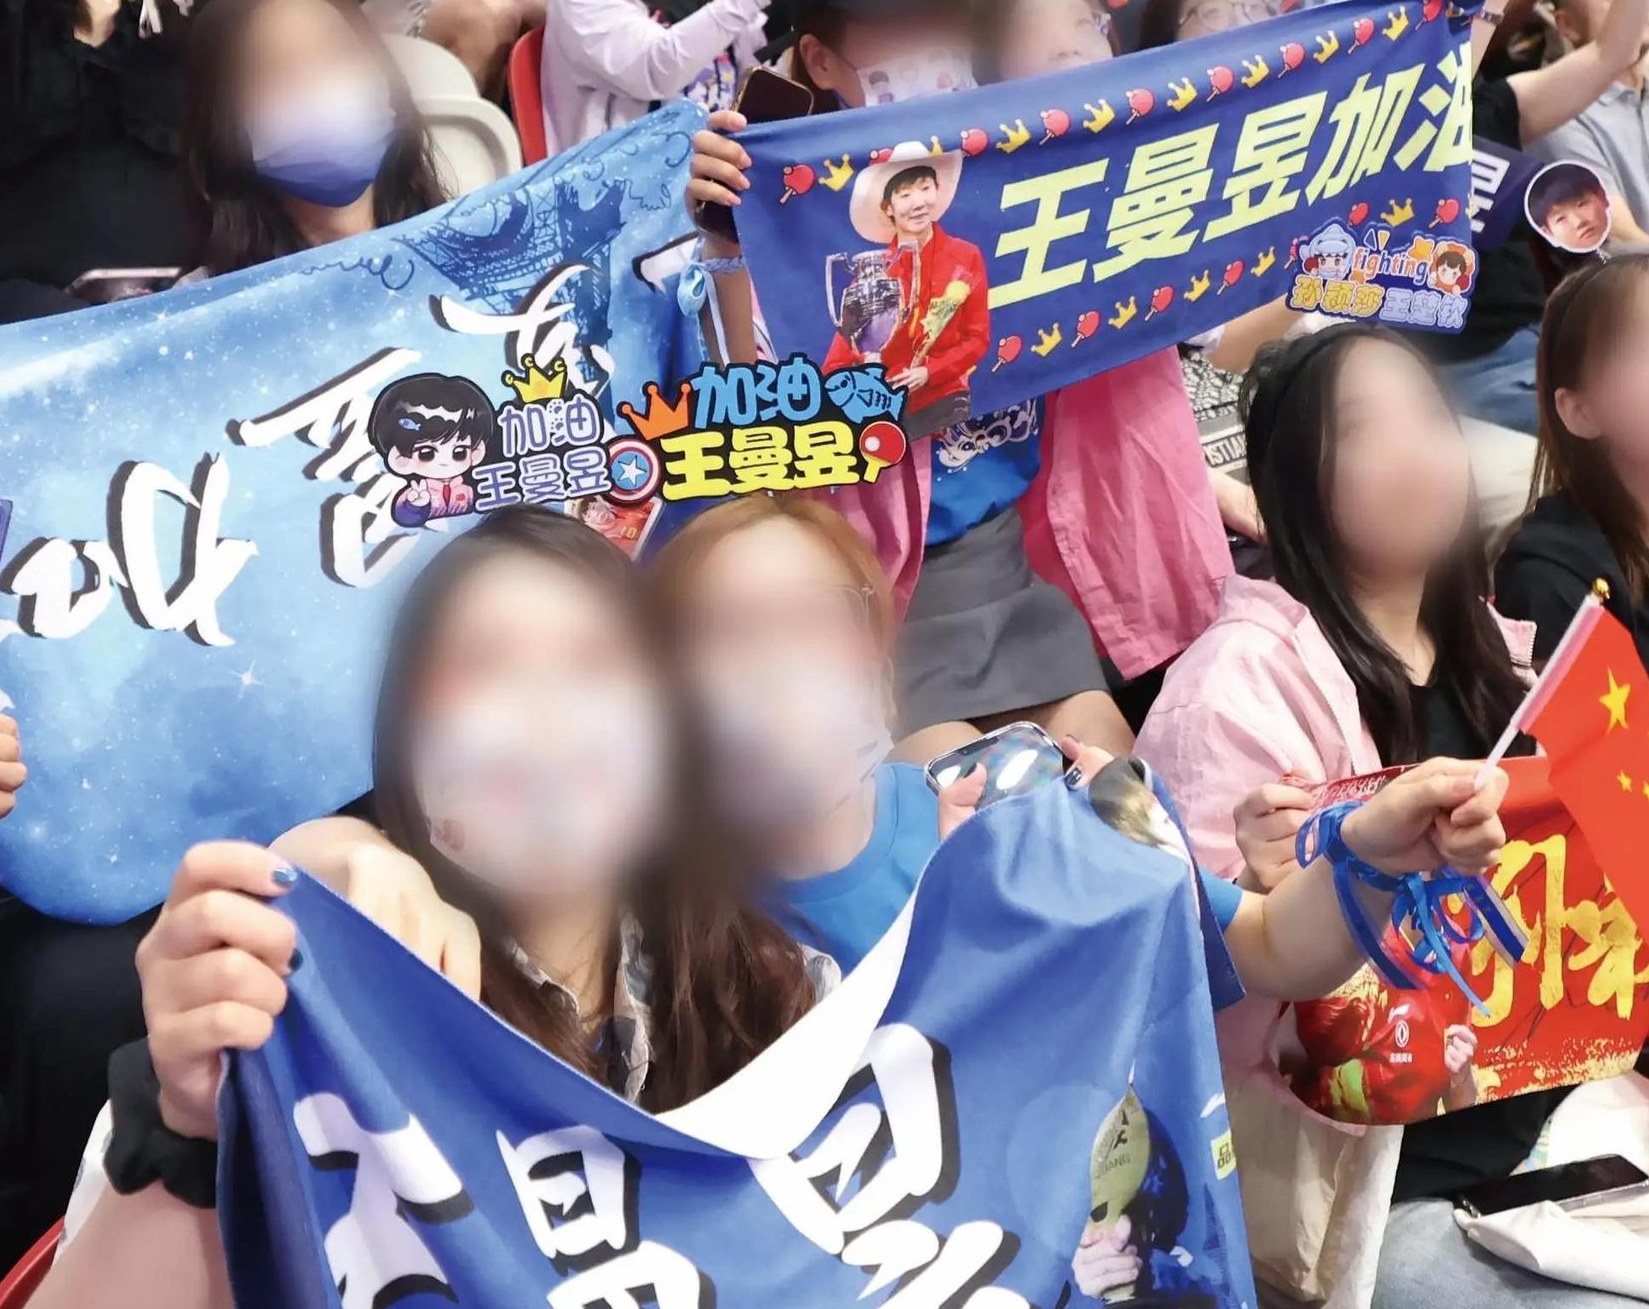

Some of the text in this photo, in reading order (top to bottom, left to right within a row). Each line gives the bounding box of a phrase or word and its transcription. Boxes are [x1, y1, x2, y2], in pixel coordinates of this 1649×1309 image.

[1290, 275, 1385, 317] 孙颖莎
[1353, 247, 1430, 284] fighting
[691, 355, 822, 429] 加油
[495, 393, 606, 455] 加油
[474, 447, 614, 512] 王曼昱
[662, 424, 861, 502] 王曼昱
